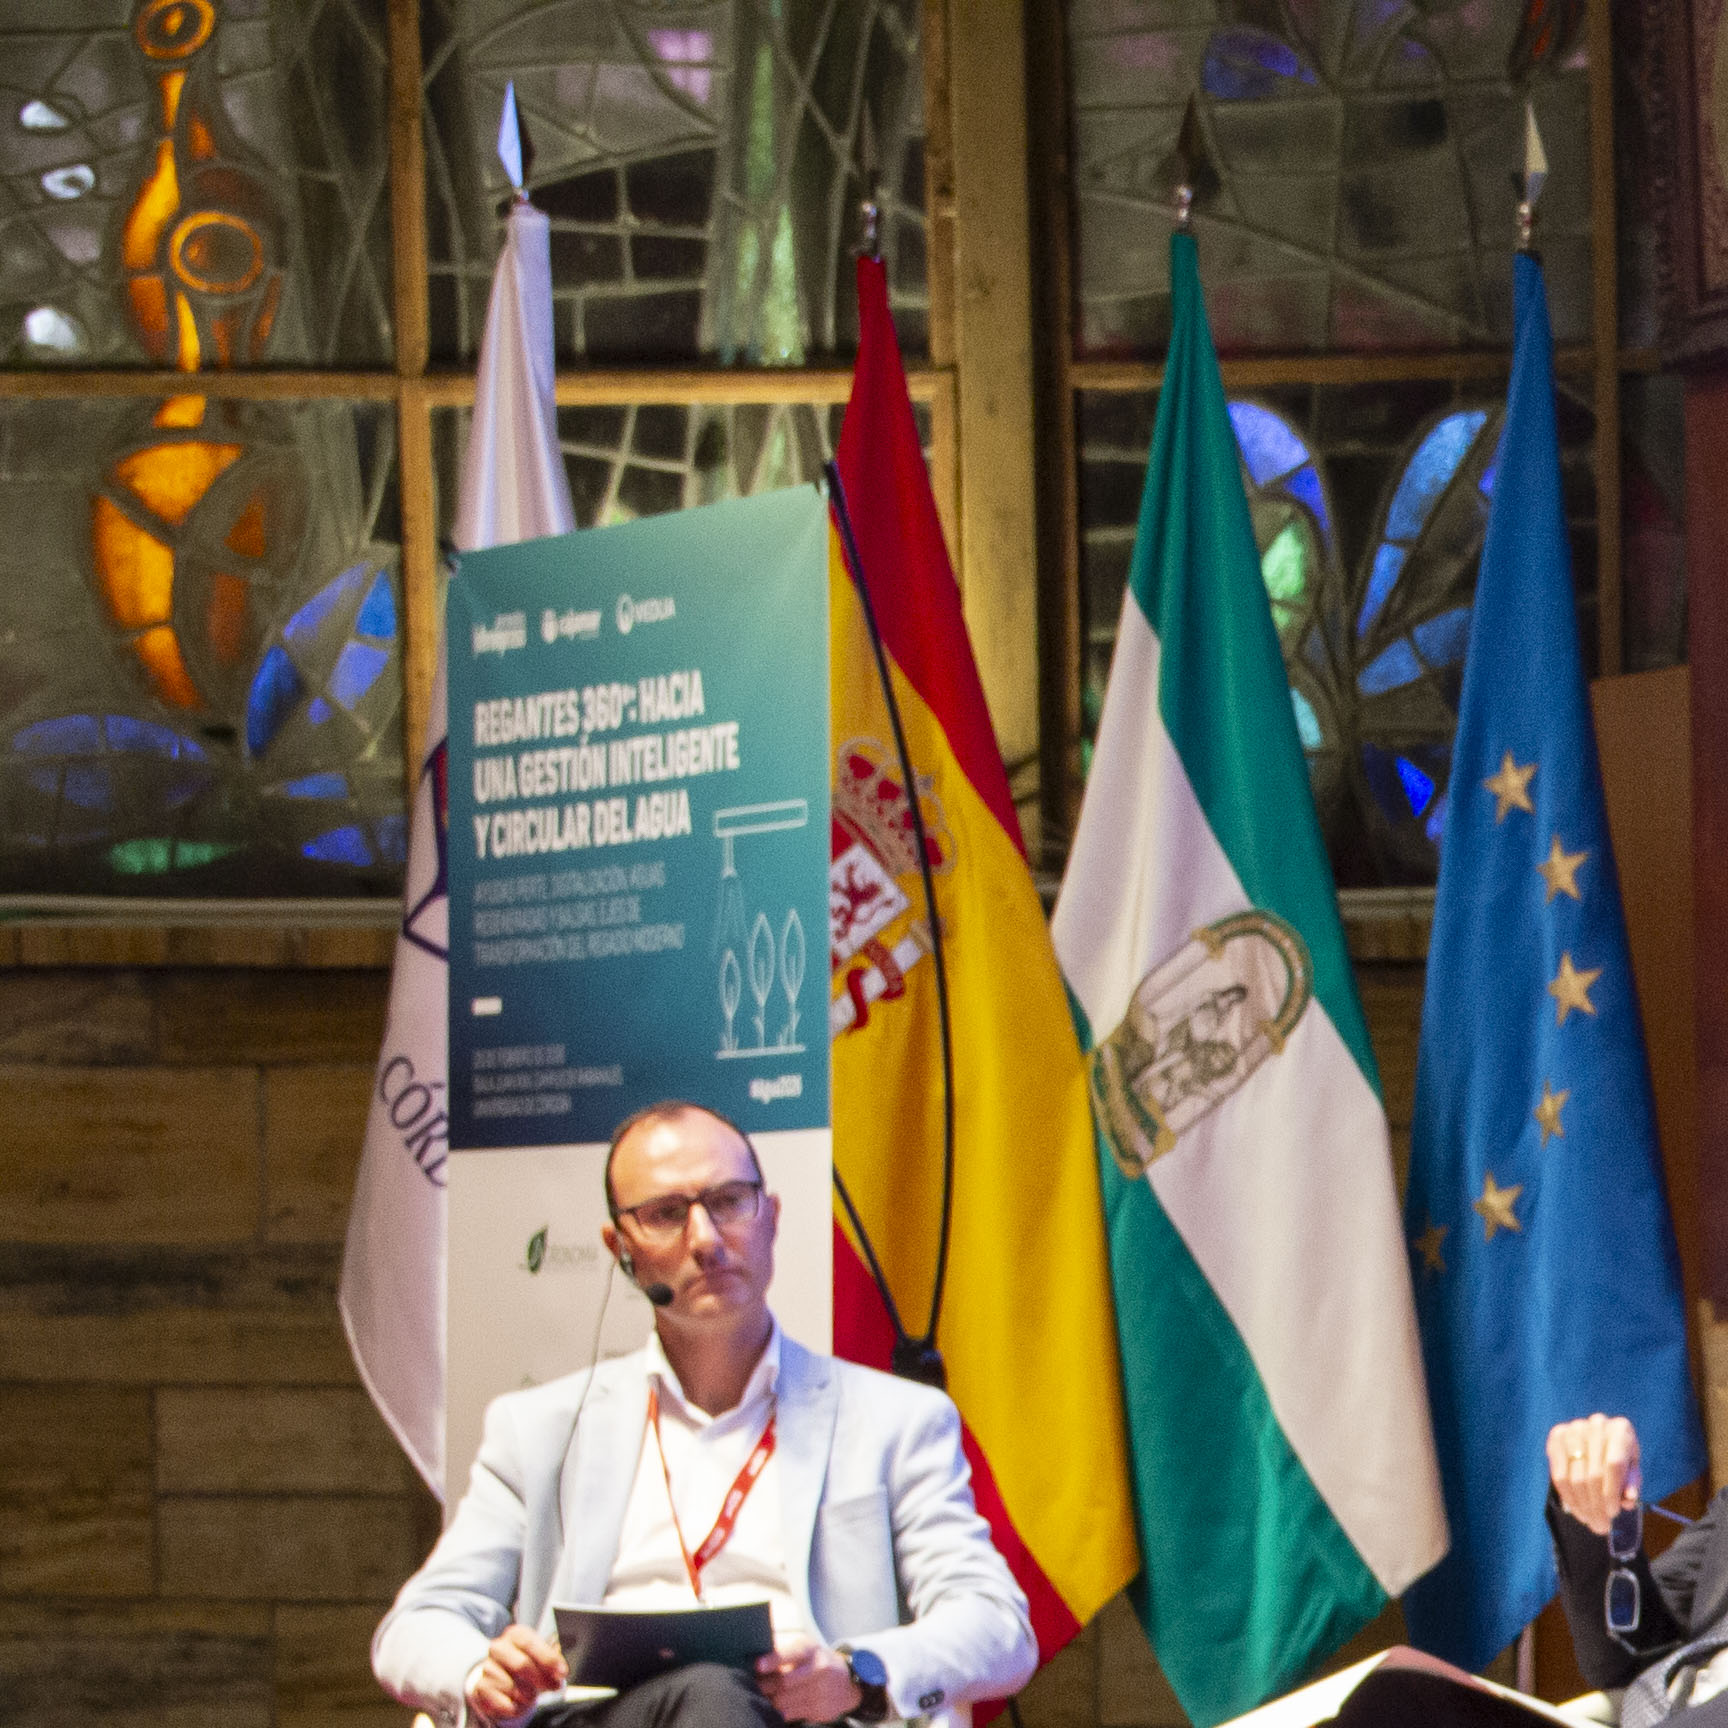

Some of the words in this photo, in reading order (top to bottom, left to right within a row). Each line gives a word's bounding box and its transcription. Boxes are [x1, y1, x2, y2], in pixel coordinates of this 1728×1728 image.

[474, 689, 580, 748] REGANTES
[638, 668, 705, 724] HACIA
[473, 755, 518, 804] UNA
[518, 733, 607, 798] GESTIÓN
[608, 721, 740, 786] INTELIGENTE
[473, 814, 491, 860] Y
[491, 802, 592, 859] CIRCULAR
[592, 798, 634, 848] DEL
[633, 789, 693, 842] AGUA
